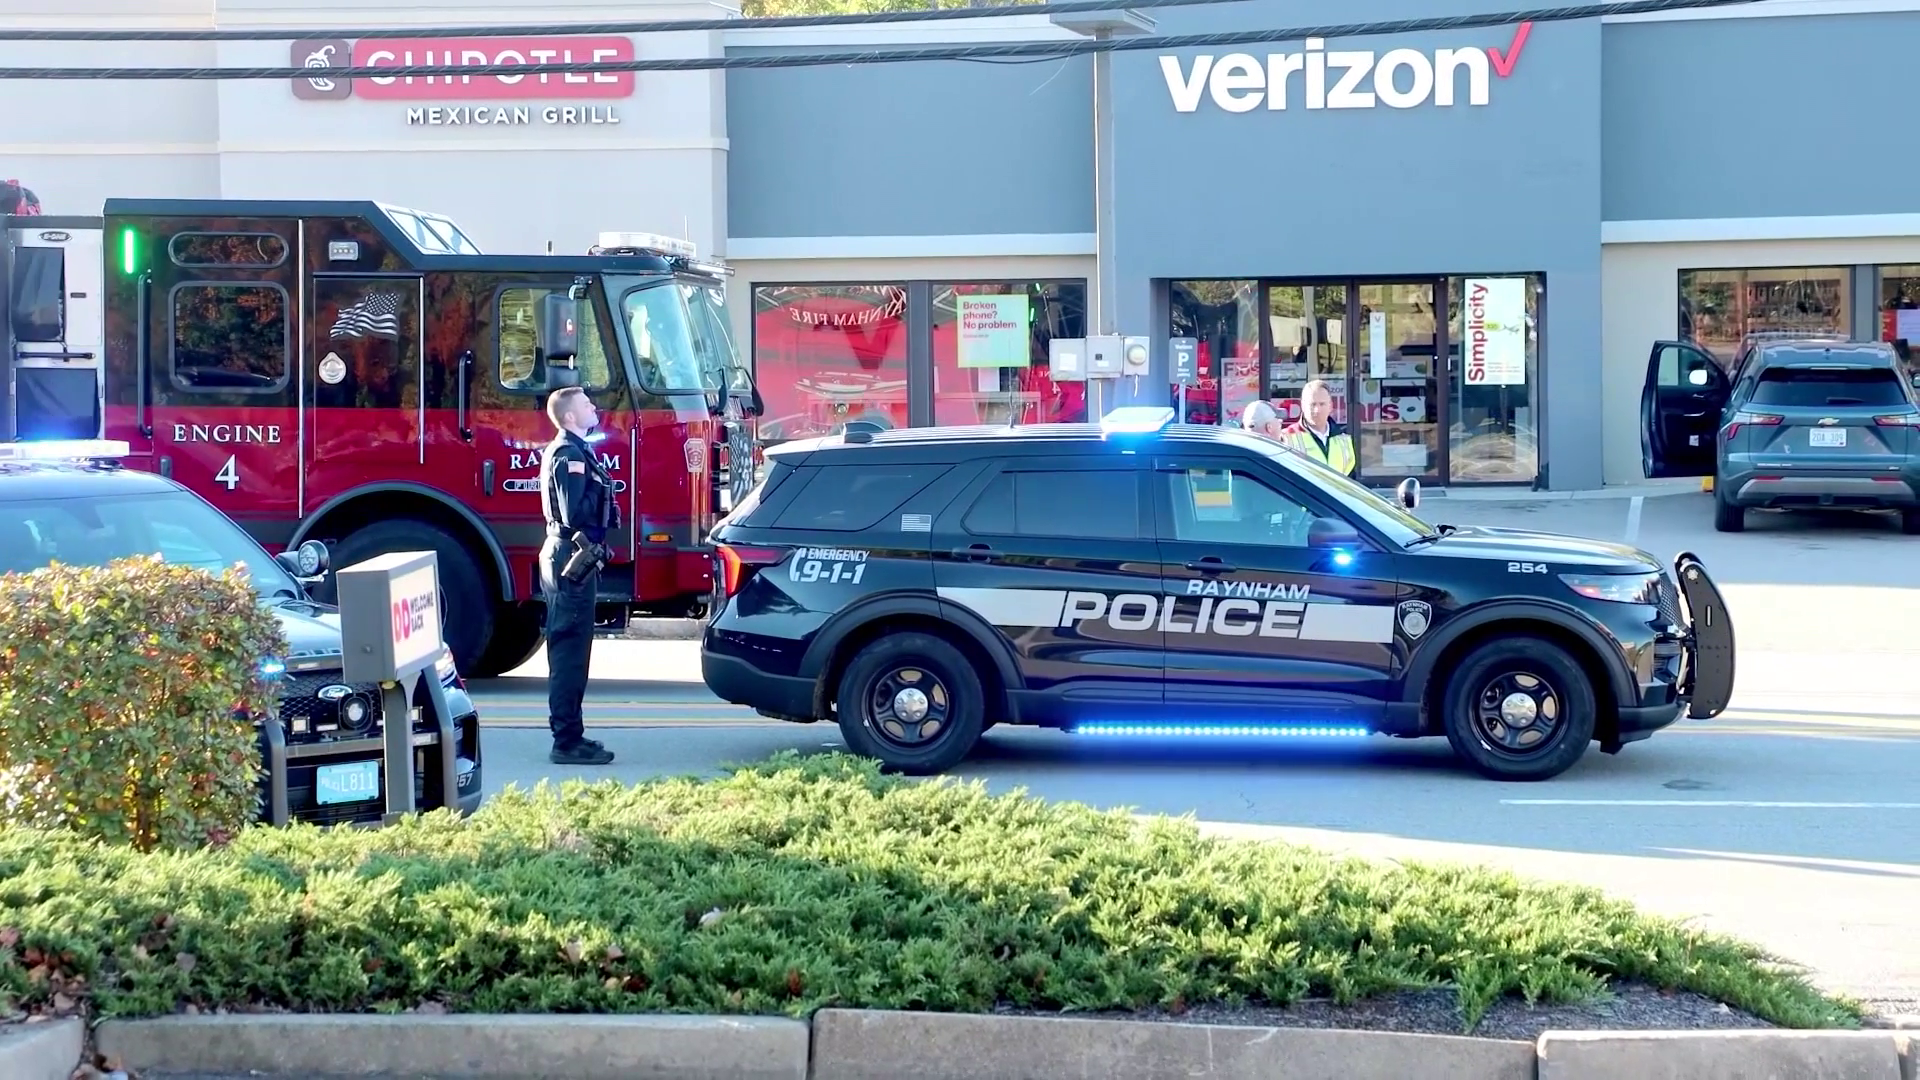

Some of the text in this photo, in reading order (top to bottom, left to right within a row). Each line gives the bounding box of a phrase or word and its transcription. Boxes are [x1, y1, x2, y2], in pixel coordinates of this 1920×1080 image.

[366, 49, 619, 85] CHIPOTLE
[1158, 37, 1490, 113] verizon
[406, 105, 620, 125] MEXICAN GRILL
[963, 301, 997, 310] Broken
[963, 310, 998, 321] phone?
[963, 320, 1017, 330] No problem
[1468, 283, 1489, 382] Simplicity
[1178, 352, 1189, 367] P
[173, 424, 281, 443] ENGINE
[214, 453, 240, 490] 4
[514, 481, 541, 490] FIR
[807, 547, 870, 562] EMERGENCY
[800, 560, 867, 584] 9-1-1
[1507, 562, 1549, 574] 254
[1186, 579, 1311, 600] RAYNHAM
[411, 590, 434, 614] WELCOME
[1060, 591, 1301, 639] POLICE
[341, 771, 375, 792] L811
[457, 773, 473, 787] 57
